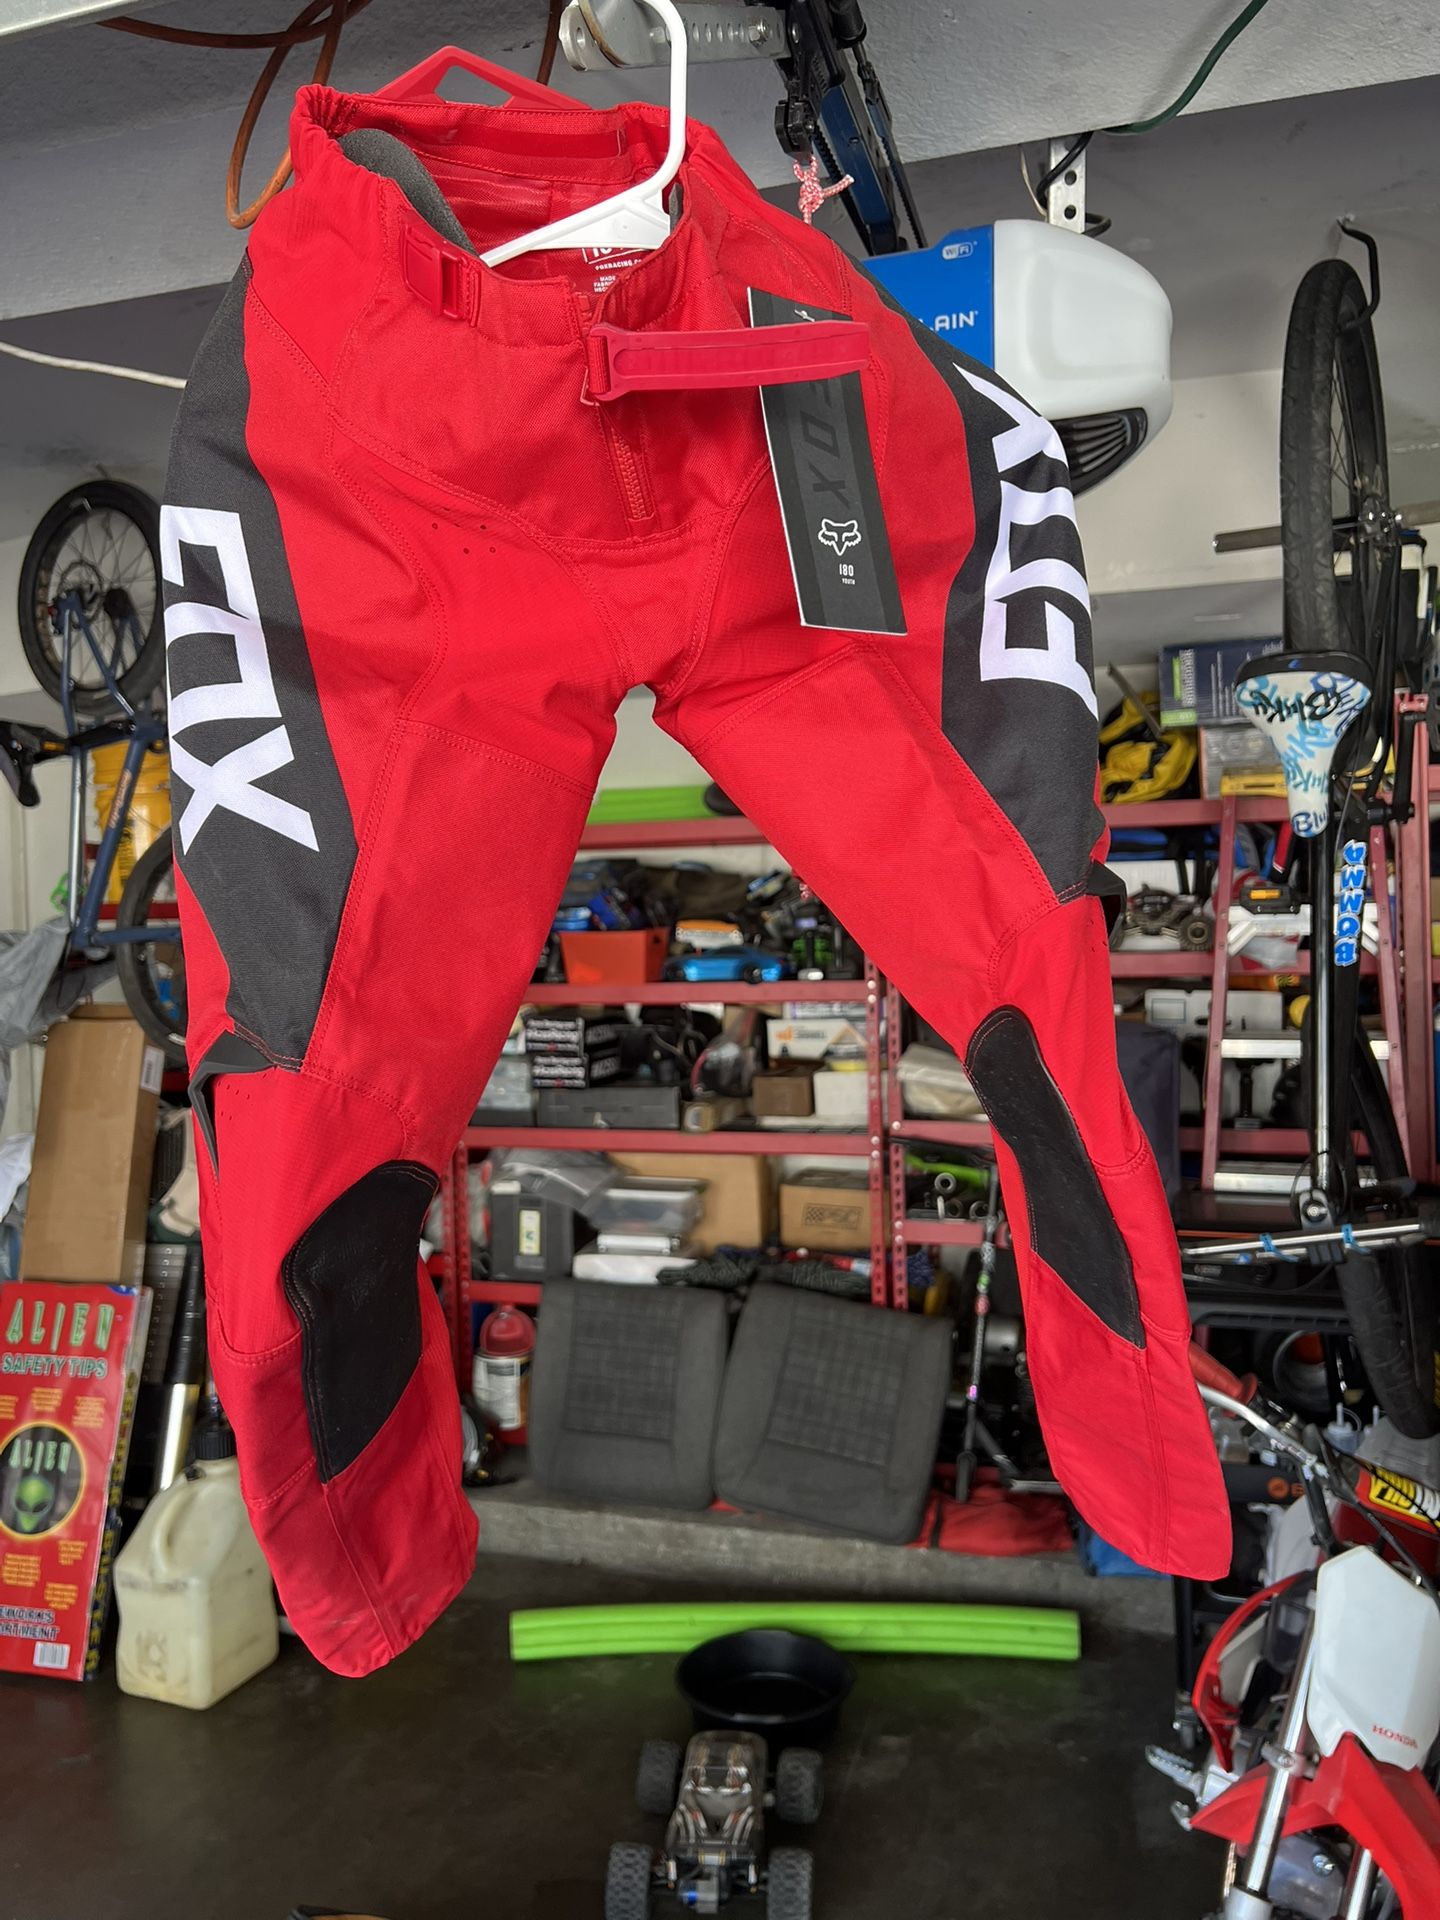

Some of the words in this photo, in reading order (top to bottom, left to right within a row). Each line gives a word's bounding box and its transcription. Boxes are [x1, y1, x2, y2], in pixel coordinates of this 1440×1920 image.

[943, 243, 973, 260] WiFi
[919, 311, 975, 332] AIN
[952, 361, 1099, 721] FOX
[839, 563, 854, 577] 180
[159, 504, 320, 856] FOX
[6, 1297, 115, 1353] ALIEN
[2, 1352, 65, 1377] SAFETY
[69, 1356, 108, 1379] TIPS
[8, 1437, 72, 1475] ALIEN
[1372, 1725, 1418, 1749] HONDA
